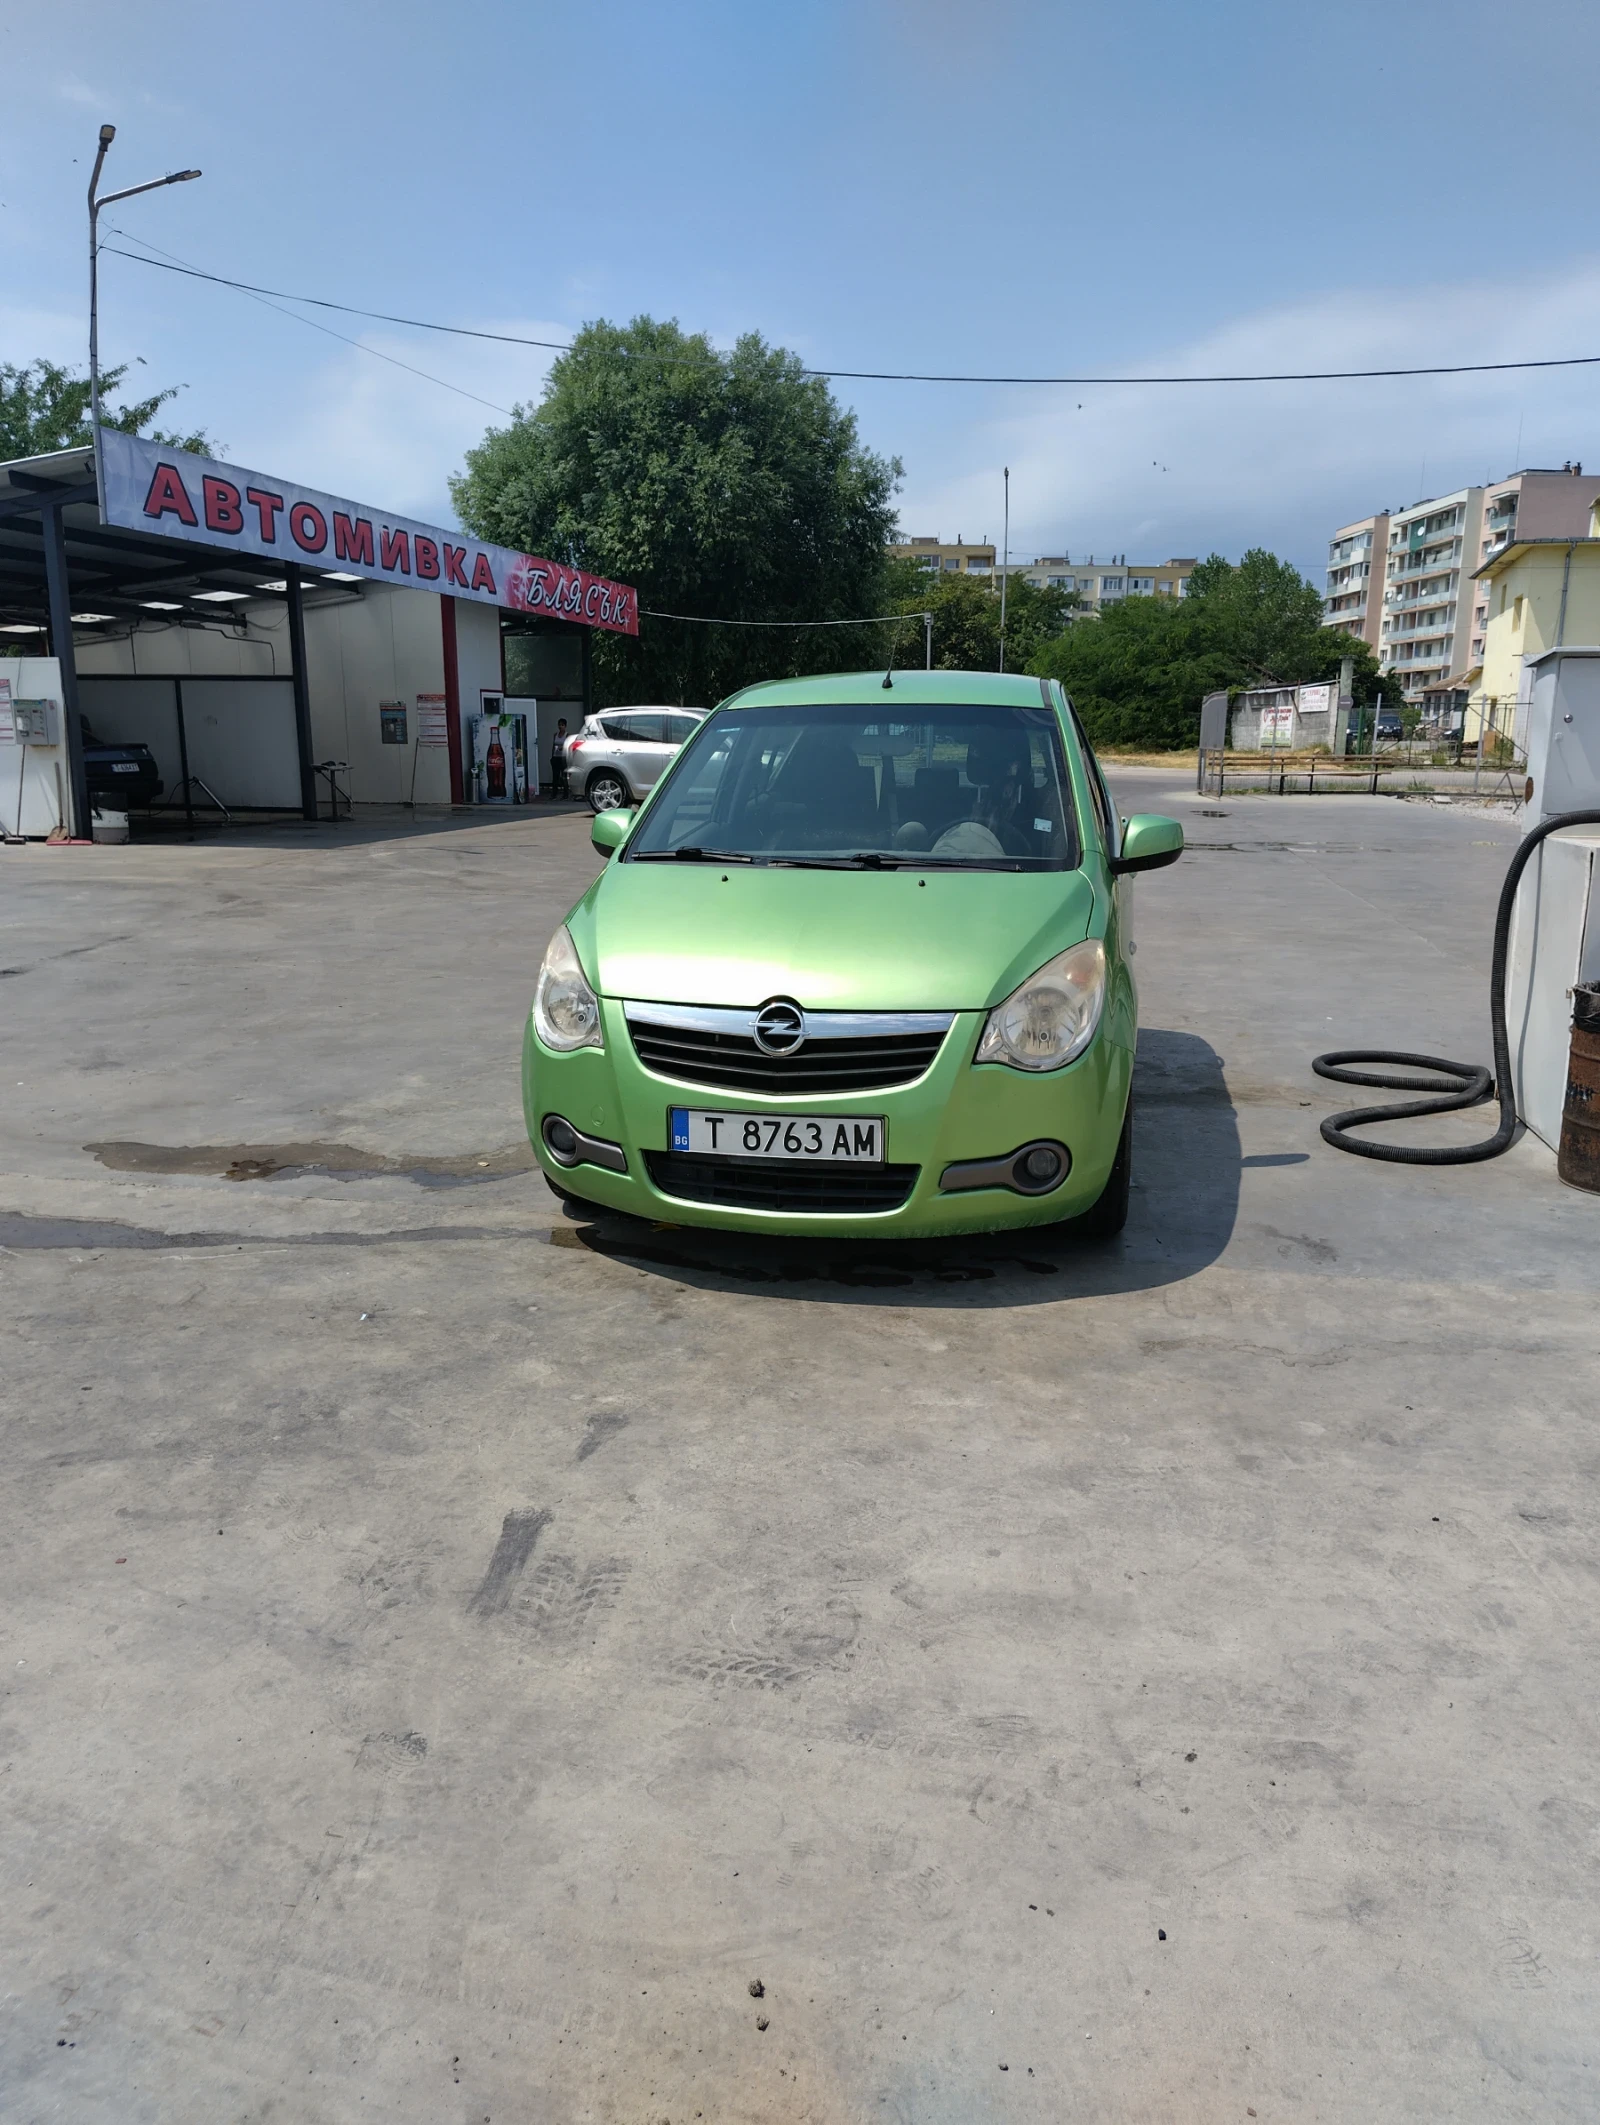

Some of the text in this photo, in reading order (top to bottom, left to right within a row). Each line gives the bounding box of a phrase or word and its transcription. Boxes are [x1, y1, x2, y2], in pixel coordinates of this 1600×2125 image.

[143, 461, 629, 625] АВТОМИВКА БЛЯСЪК
[674, 1135, 688, 1146] BG
[704, 1117, 875, 1156] T 8763 AM
